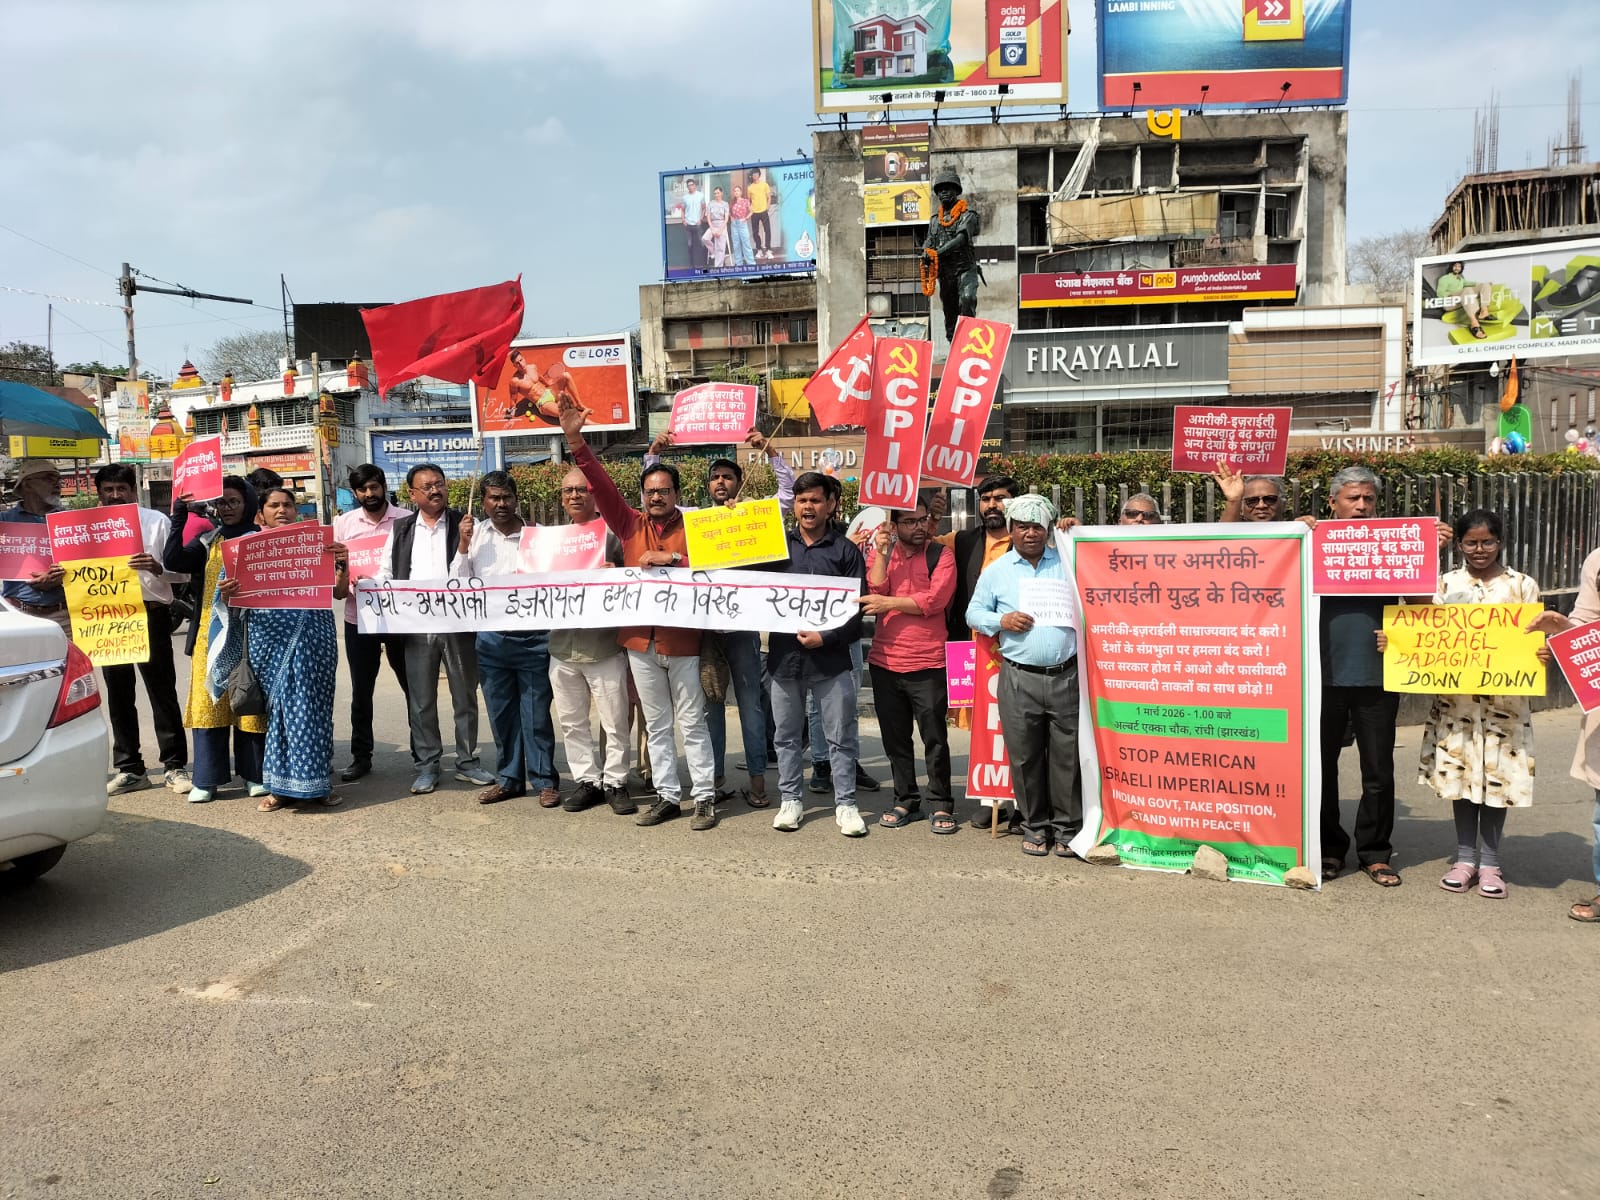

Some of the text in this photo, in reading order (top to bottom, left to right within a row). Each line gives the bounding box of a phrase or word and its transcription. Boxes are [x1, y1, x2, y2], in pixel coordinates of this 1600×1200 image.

[1000, 5, 1025, 15] adani
[1108, 1, 1175, 12] LAMBI INNING
[1001, 16, 1025, 26] ACC
[784, 170, 814, 181] FASHIO
[1182, 270, 1261, 286] punjab national bank
[1424, 294, 1478, 309] KEEP IT
[1484, 344, 1515, 352] CHURCH
[1558, 338, 1579, 346] MAIN
[1026, 342, 1180, 381] FIRAYALAL
[1188, 412, 1275, 428] अमरीकी-इज़राईली
[1238, 427, 1253, 440] बंद
[382, 437, 484, 452] HEALTH HOME
[1184, 439, 1204, 449] अन्य
[1206, 438, 1226, 450] देशों
[1228, 438, 1238, 451] के
[812, 449, 857, 468] FOD
[1186, 451, 1199, 460] पर
[1230, 450, 1243, 464] बंद
[54, 517, 130, 537] ईरान पर अमरीकी-
[1326, 524, 1421, 540] अमरीकी-इज़राईली
[24, 536, 36, 544] पर
[92, 532, 111, 544] युद्ध
[246, 540, 266, 551] भारत
[268, 536, 296, 548] सरकार
[316, 532, 324, 541] में
[244, 549, 266, 562] आओ
[267, 545, 282, 557] और
[285, 543, 324, 556] फासीवादी
[1322, 542, 1379, 554] साम्राज्यवाद
[1381, 540, 1398, 553] बंद
[294, 554, 322, 567] ताकतों
[1108, 546, 1266, 571] ईरान पर अमरीकी-
[1324, 552, 1424, 569] अन्य देशों के संप्रभुता
[70, 566, 114, 583] MODI
[254, 572, 266, 582] का
[268, 570, 286, 581] साथ
[1326, 569, 1341, 580] पर
[1343, 568, 1372, 582] हमला
[1374, 566, 1390, 580] बंद
[88, 580, 129, 596] GOVT
[654, 570, 678, 614] के
[1085, 582, 1160, 606] इज़राईली
[1167, 587, 1200, 610] युद्ध
[1206, 582, 1225, 605] के
[1231, 582, 1286, 609] विरुद्ध
[82, 604, 137, 621] STAND
[1392, 607, 1523, 630] AMERICAN
[79, 620, 144, 638] WITH PEACE
[1091, 622, 1280, 638] अमरीकी-इज़राईली साम्राज्यवाद बंद करो
[1102, 640, 1264, 658] देशों के संप्रभुता पर हमला बंद करो
[1416, 630, 1498, 651] ISRAEL
[88, 645, 146, 659] PERIALISM
[1394, 651, 1491, 668] DADAGIRI
[1118, 660, 1288, 677] सरकार होश में आओ और फासीवादी
[1401, 670, 1538, 688] DOWN DOWN
[1104, 678, 1264, 698] साम्राज्यवादी ताकतों का साथ छोड़ो
[1136, 706, 1232, 720] 1 मार्च 2026 1.00 बजे
[1142, 722, 1166, 734] एक्का
[1169, 722, 1192, 736] चौक,
[1195, 724, 1214, 736] रांची
[1217, 725, 1260, 739] (झारखंड)
[1119, 746, 1256, 770] STOP AMERICAN
[1158, 776, 1270, 796] IMPERIALISM
[1276, 783, 1286, 798] !!
[1112, 788, 1277, 818] INDIAN GOVT, TAKE POSITION,
[1131, 811, 1166, 826] STAND
[1169, 816, 1200, 829] WITH
[1202, 818, 1241, 832] PEACE
